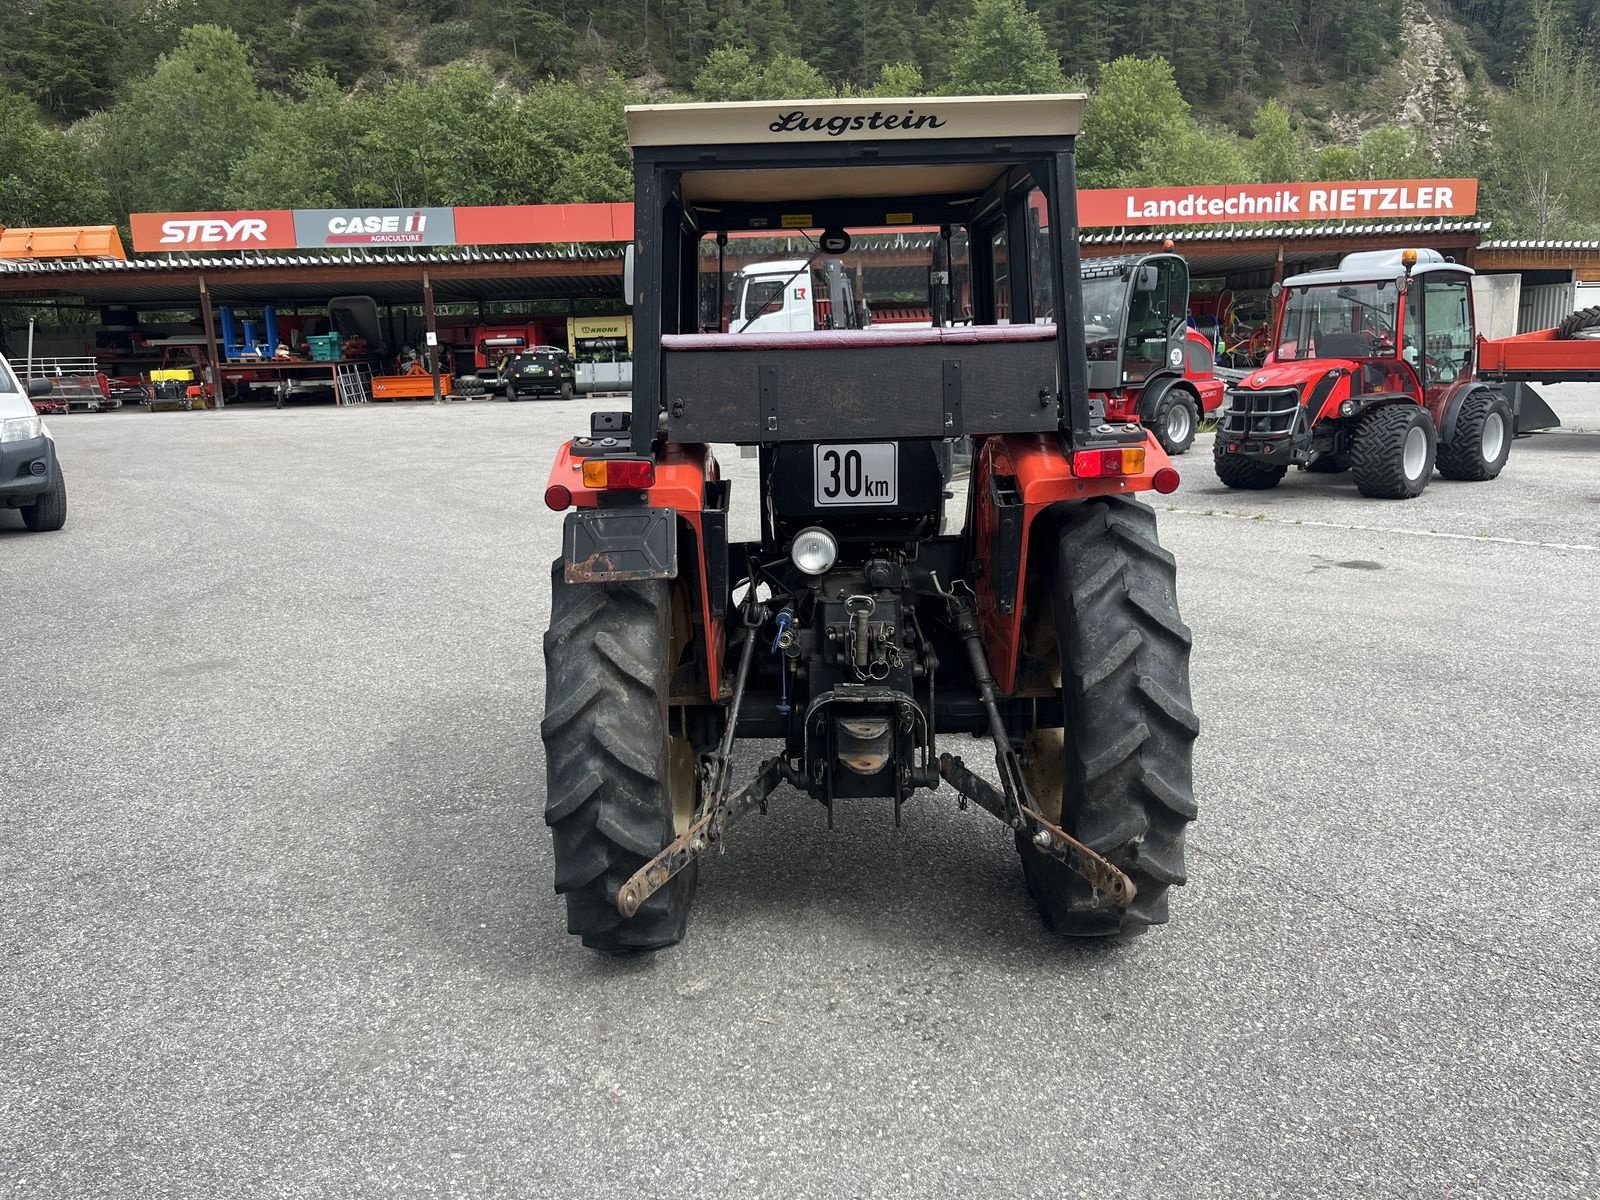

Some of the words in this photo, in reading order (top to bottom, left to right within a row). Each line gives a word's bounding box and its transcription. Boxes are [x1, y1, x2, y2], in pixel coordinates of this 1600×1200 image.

[769, 109, 948, 137] Lugstein
[1126, 191, 1300, 218] Landtechnik
[1308, 186, 1454, 212] RIETZLER
[159, 218, 268, 243] STEYR
[328, 215, 400, 234] CASE
[370, 234, 420, 242] AGRICULTURE
[823, 449, 862, 498] 30
[864, 475, 889, 497] km
